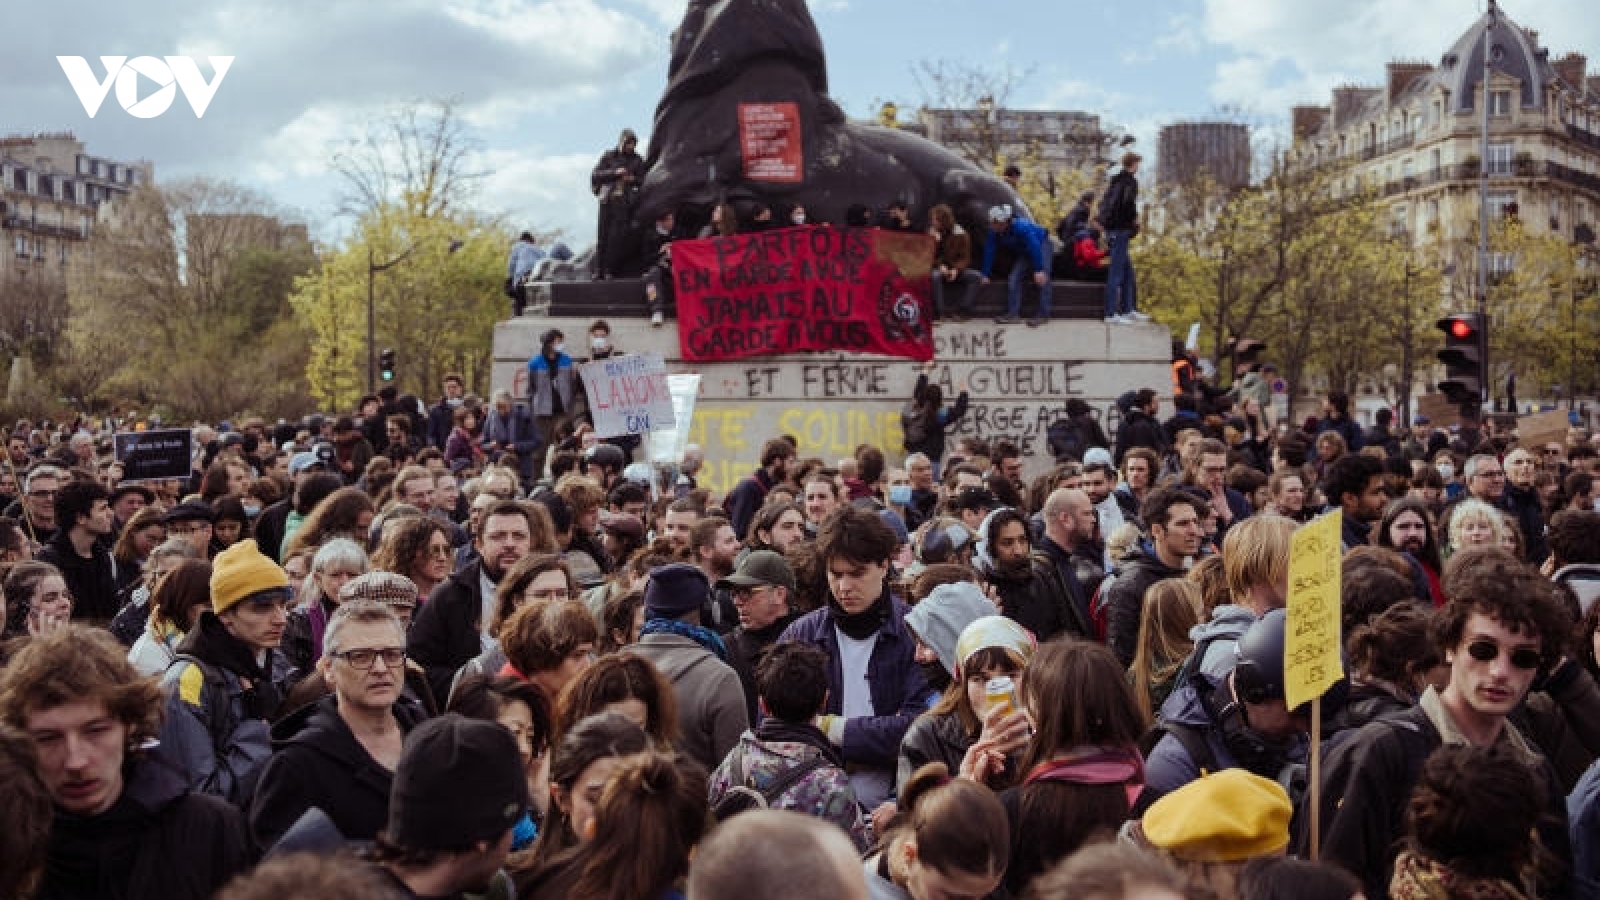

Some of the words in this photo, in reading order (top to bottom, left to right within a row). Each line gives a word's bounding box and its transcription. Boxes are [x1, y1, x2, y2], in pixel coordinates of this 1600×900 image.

[713, 227, 872, 264] PARFOIS
[679, 266, 711, 293] EN
[720, 260, 796, 292] GARDE
[696, 289, 806, 328] JAMAIS
[812, 285, 853, 318] AU
[687, 325, 780, 357] GARDE
[744, 367, 781, 398] ET
[802, 362, 889, 397] FERME
[967, 360, 1085, 396] GUEULE
[777, 407, 904, 454] SOLINE
